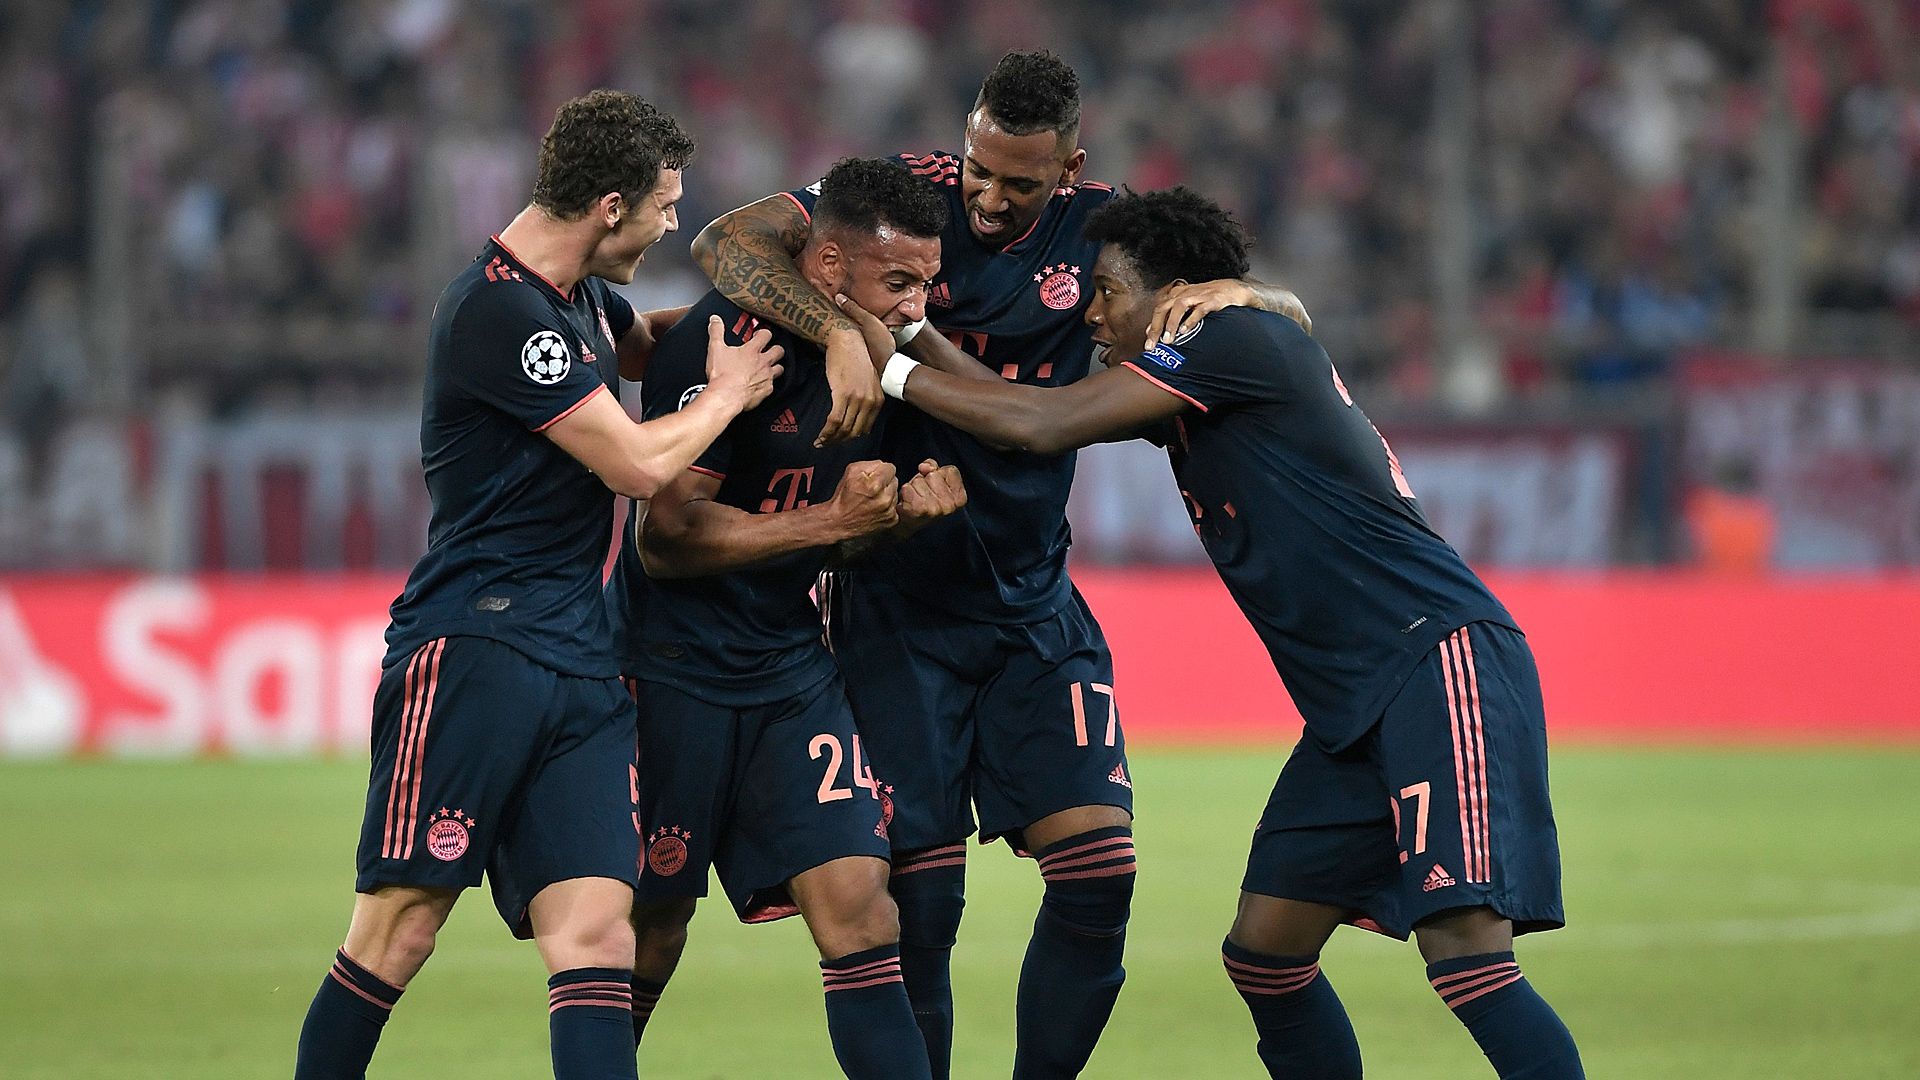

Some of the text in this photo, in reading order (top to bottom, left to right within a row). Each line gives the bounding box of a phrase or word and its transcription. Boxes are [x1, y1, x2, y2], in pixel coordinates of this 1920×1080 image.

[1050, 276, 1076, 287] BAYERN
[1150, 347, 1182, 369] SPECT
[770, 424, 798, 432] adidas
[1070, 682, 1116, 746] 17
[808, 733, 879, 804] 24
[441, 823, 465, 840] BAYERN
[1423, 877, 1455, 892] adidas
